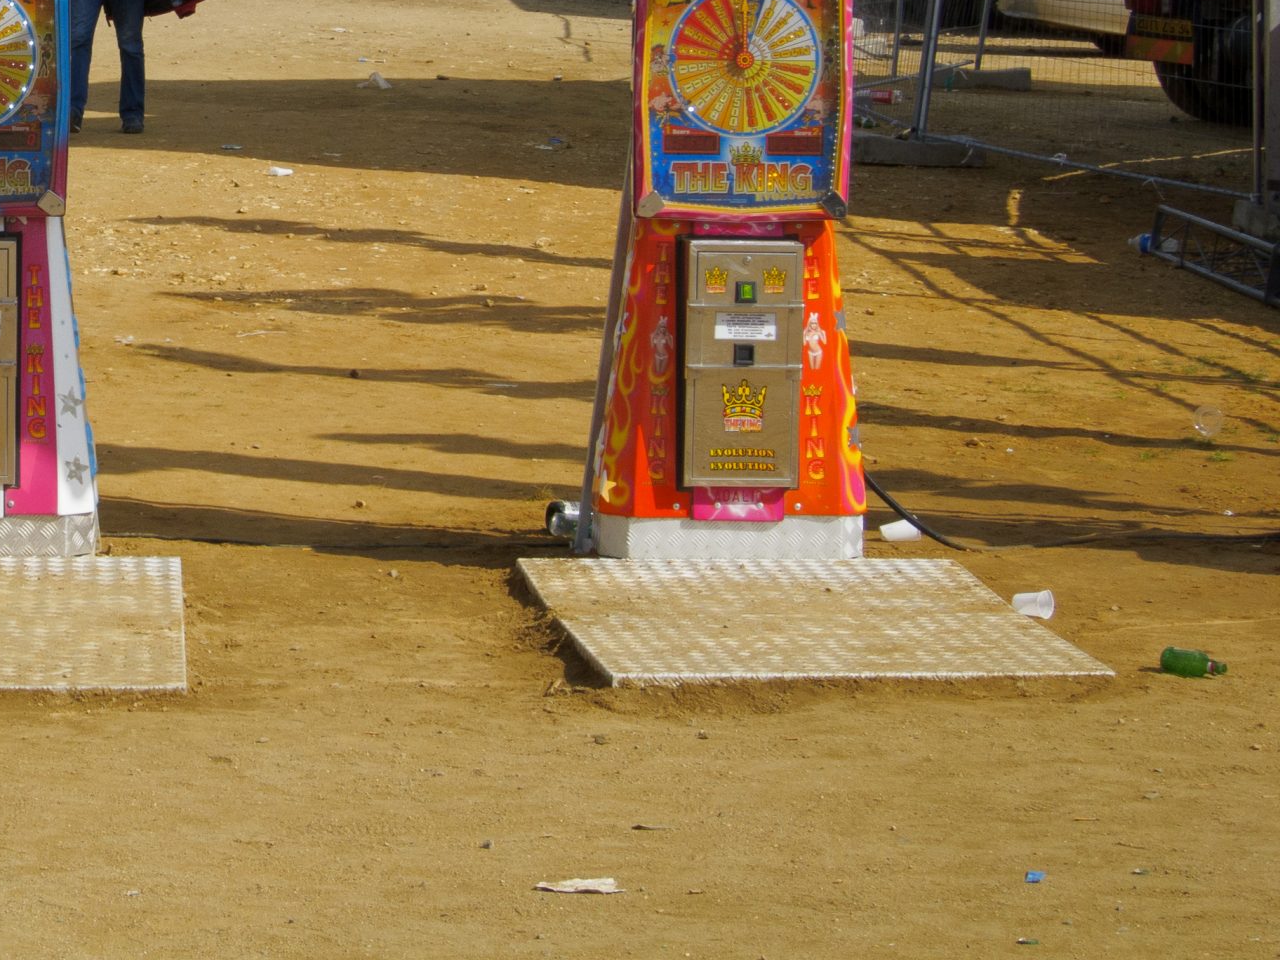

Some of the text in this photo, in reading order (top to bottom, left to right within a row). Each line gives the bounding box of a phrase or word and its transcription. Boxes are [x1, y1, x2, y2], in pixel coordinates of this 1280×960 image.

[670, 160, 814, 194] THE KING
[27, 264, 43, 329] THE
[27, 353, 47, 440] KING
[740, 417, 762, 433] KING
[804, 396, 825, 481] KING
[709, 448, 776, 458] EVOLUTION
[709, 462, 776, 471] EVOLUTION
